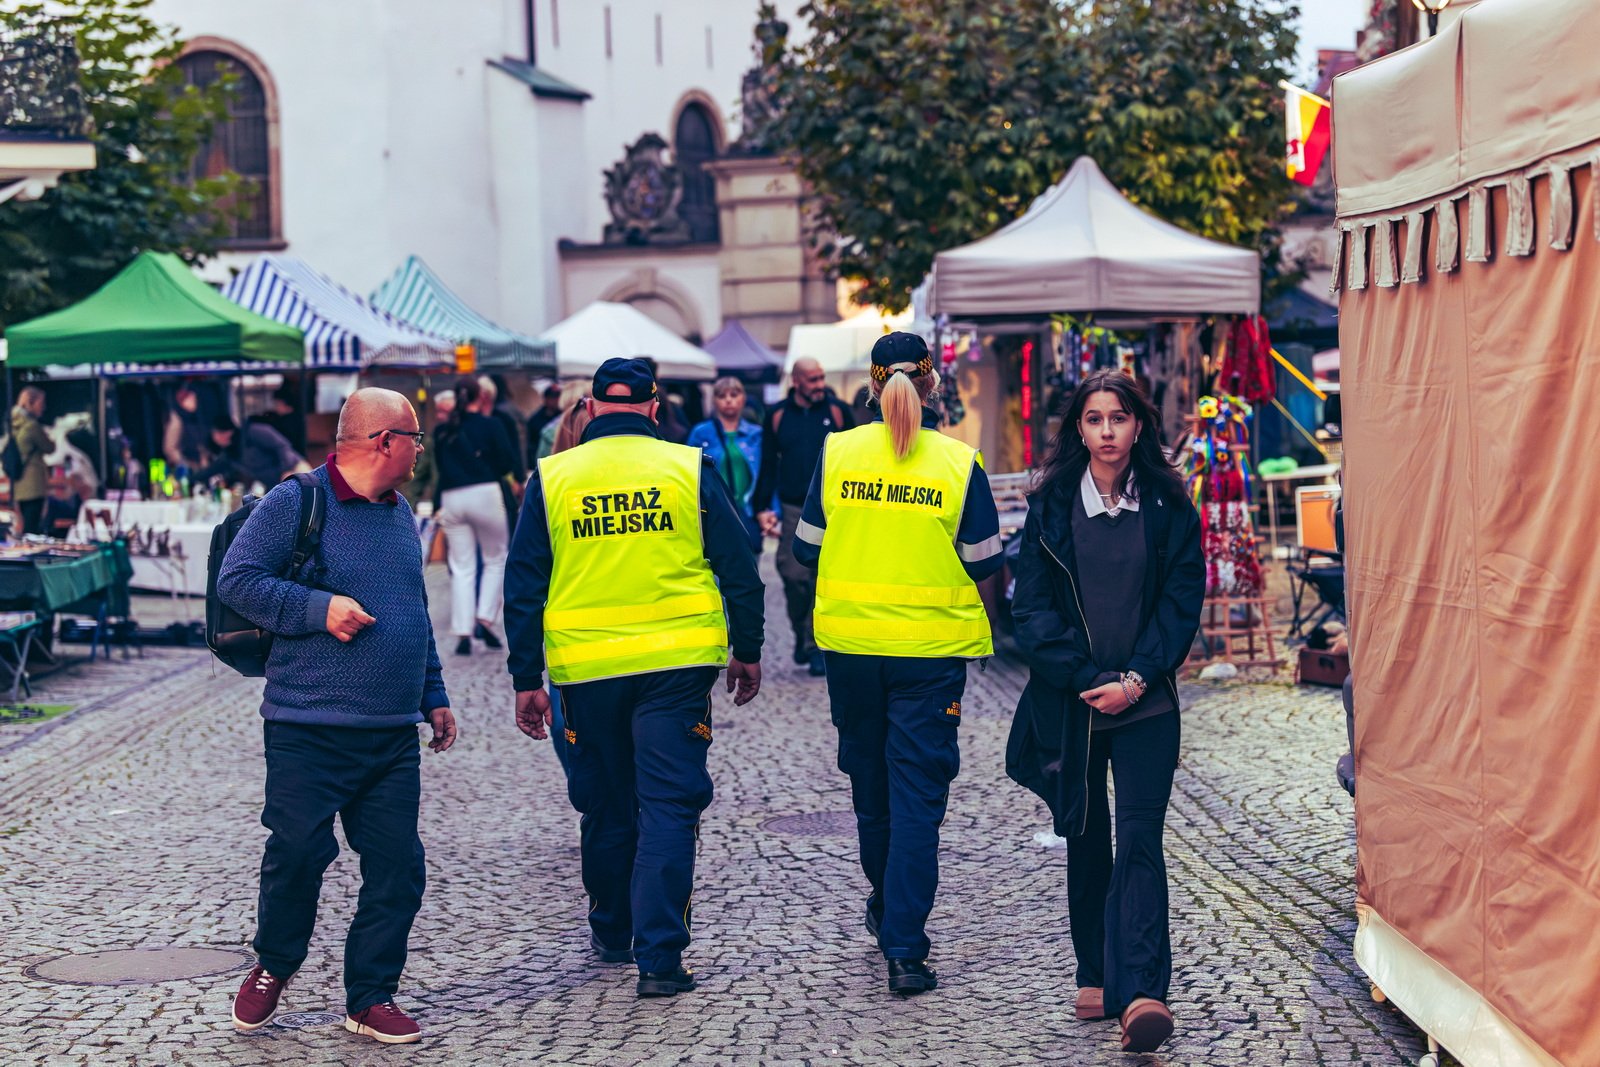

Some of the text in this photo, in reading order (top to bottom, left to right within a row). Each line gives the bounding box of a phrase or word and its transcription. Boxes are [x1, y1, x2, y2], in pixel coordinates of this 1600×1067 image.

[582, 487, 662, 515] STRAŻ
[841, 478, 943, 508] STRAŻ MIEJSKA
[571, 511, 674, 538] MIEJSKA
